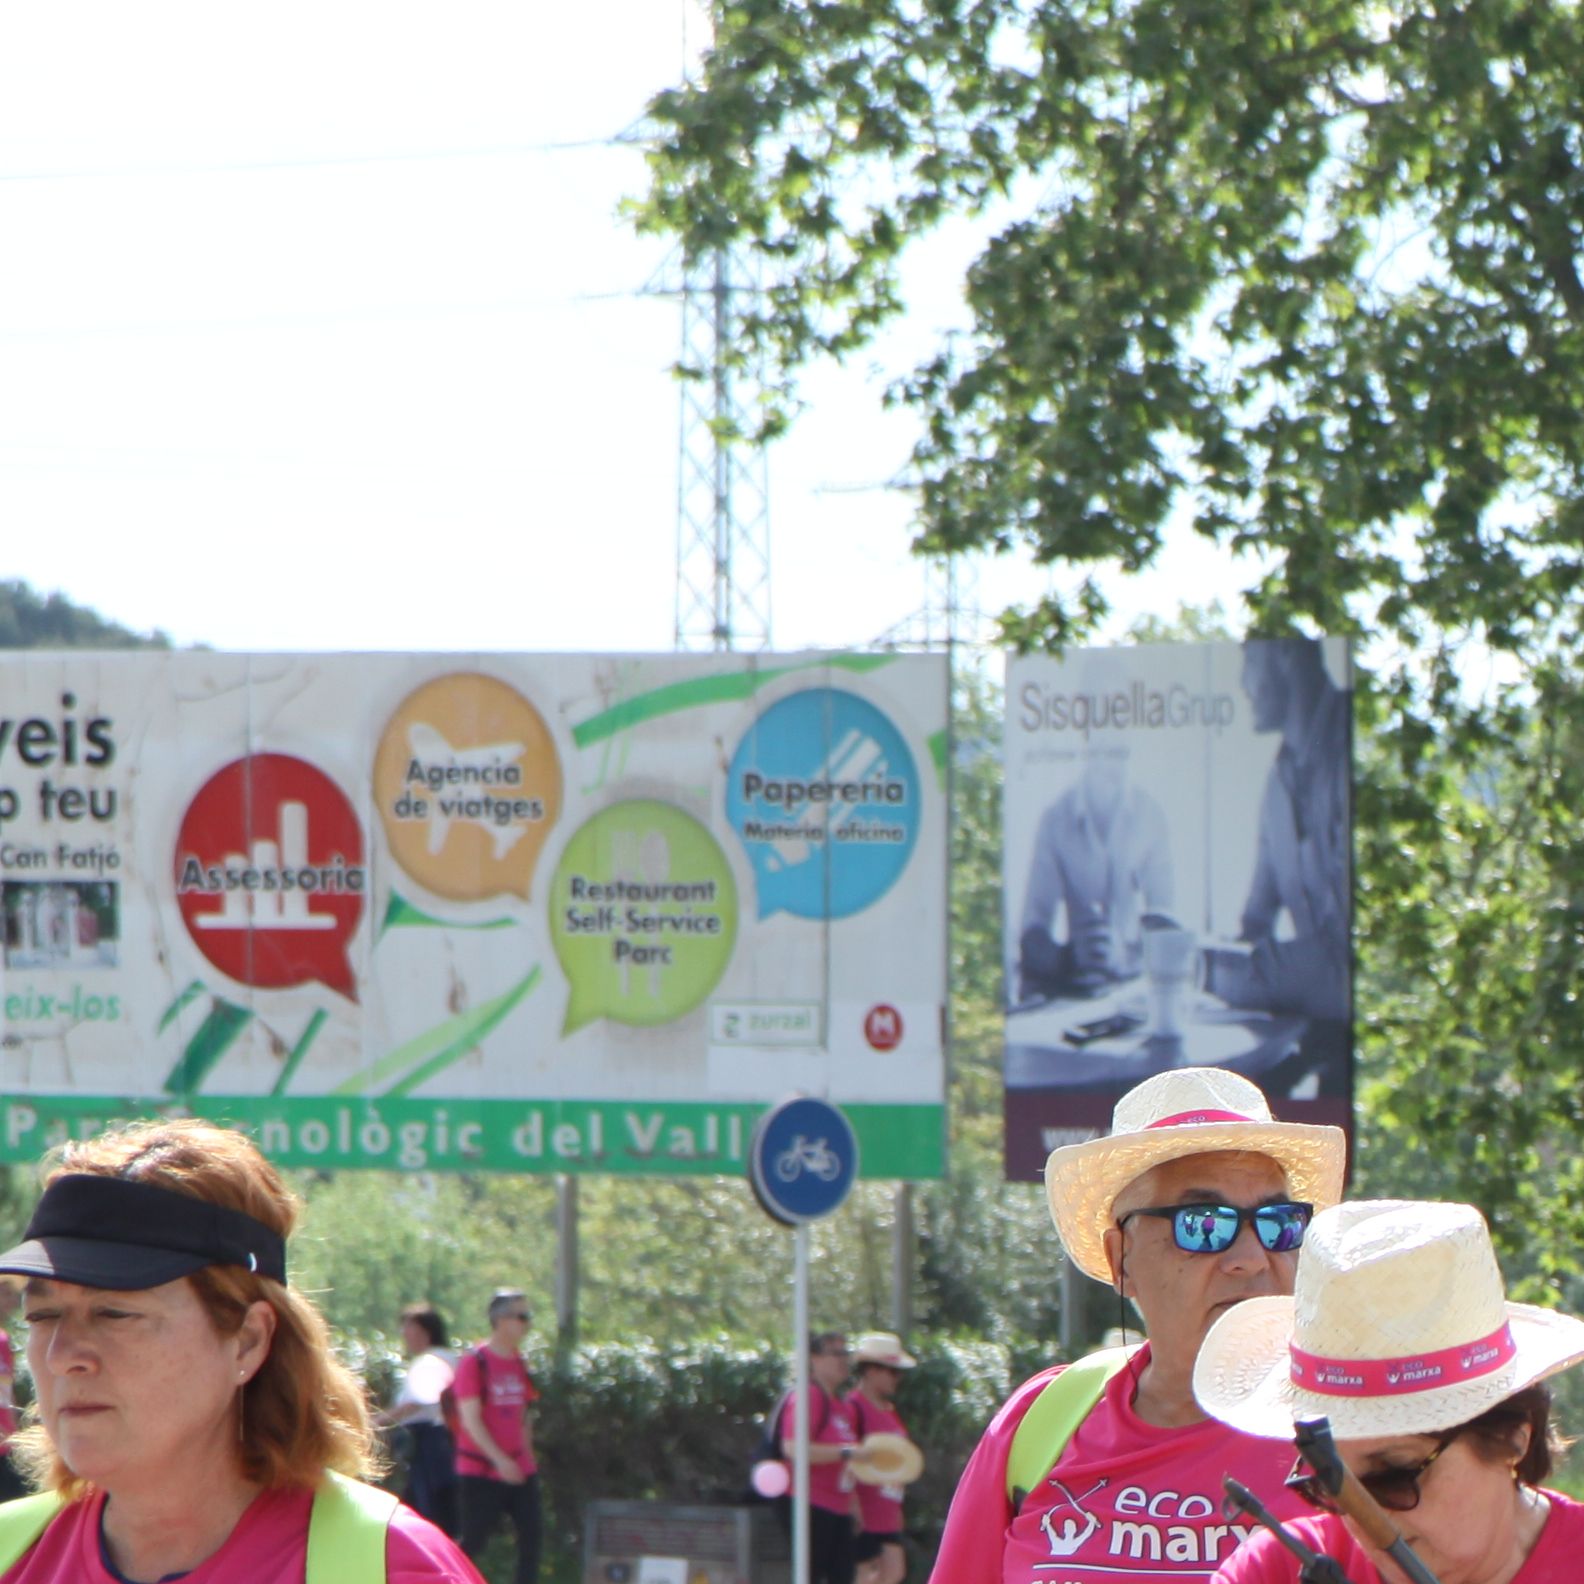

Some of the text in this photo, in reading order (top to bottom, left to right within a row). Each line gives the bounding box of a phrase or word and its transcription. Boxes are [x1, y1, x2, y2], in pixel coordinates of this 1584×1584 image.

[1020, 679, 1236, 740] SisquellaGrup
[407, 758, 520, 789] Agència
[42, 781, 116, 822] teu
[744, 772, 903, 811] Papereria
[395, 793, 542, 826] de viatges
[745, 822, 828, 841] Materia
[2, 843, 120, 876] Can Fatjó
[181, 857, 364, 892] Assessoria
[570, 878, 716, 901] Restaurant
[566, 907, 720, 934] Self-Service
[614, 940, 671, 964] Parc
[513, 1109, 604, 1156] del
[625, 1110, 742, 1162] Vall
[1403, 1366, 1441, 1382] marxa
[1115, 1486, 1214, 1520] eco
